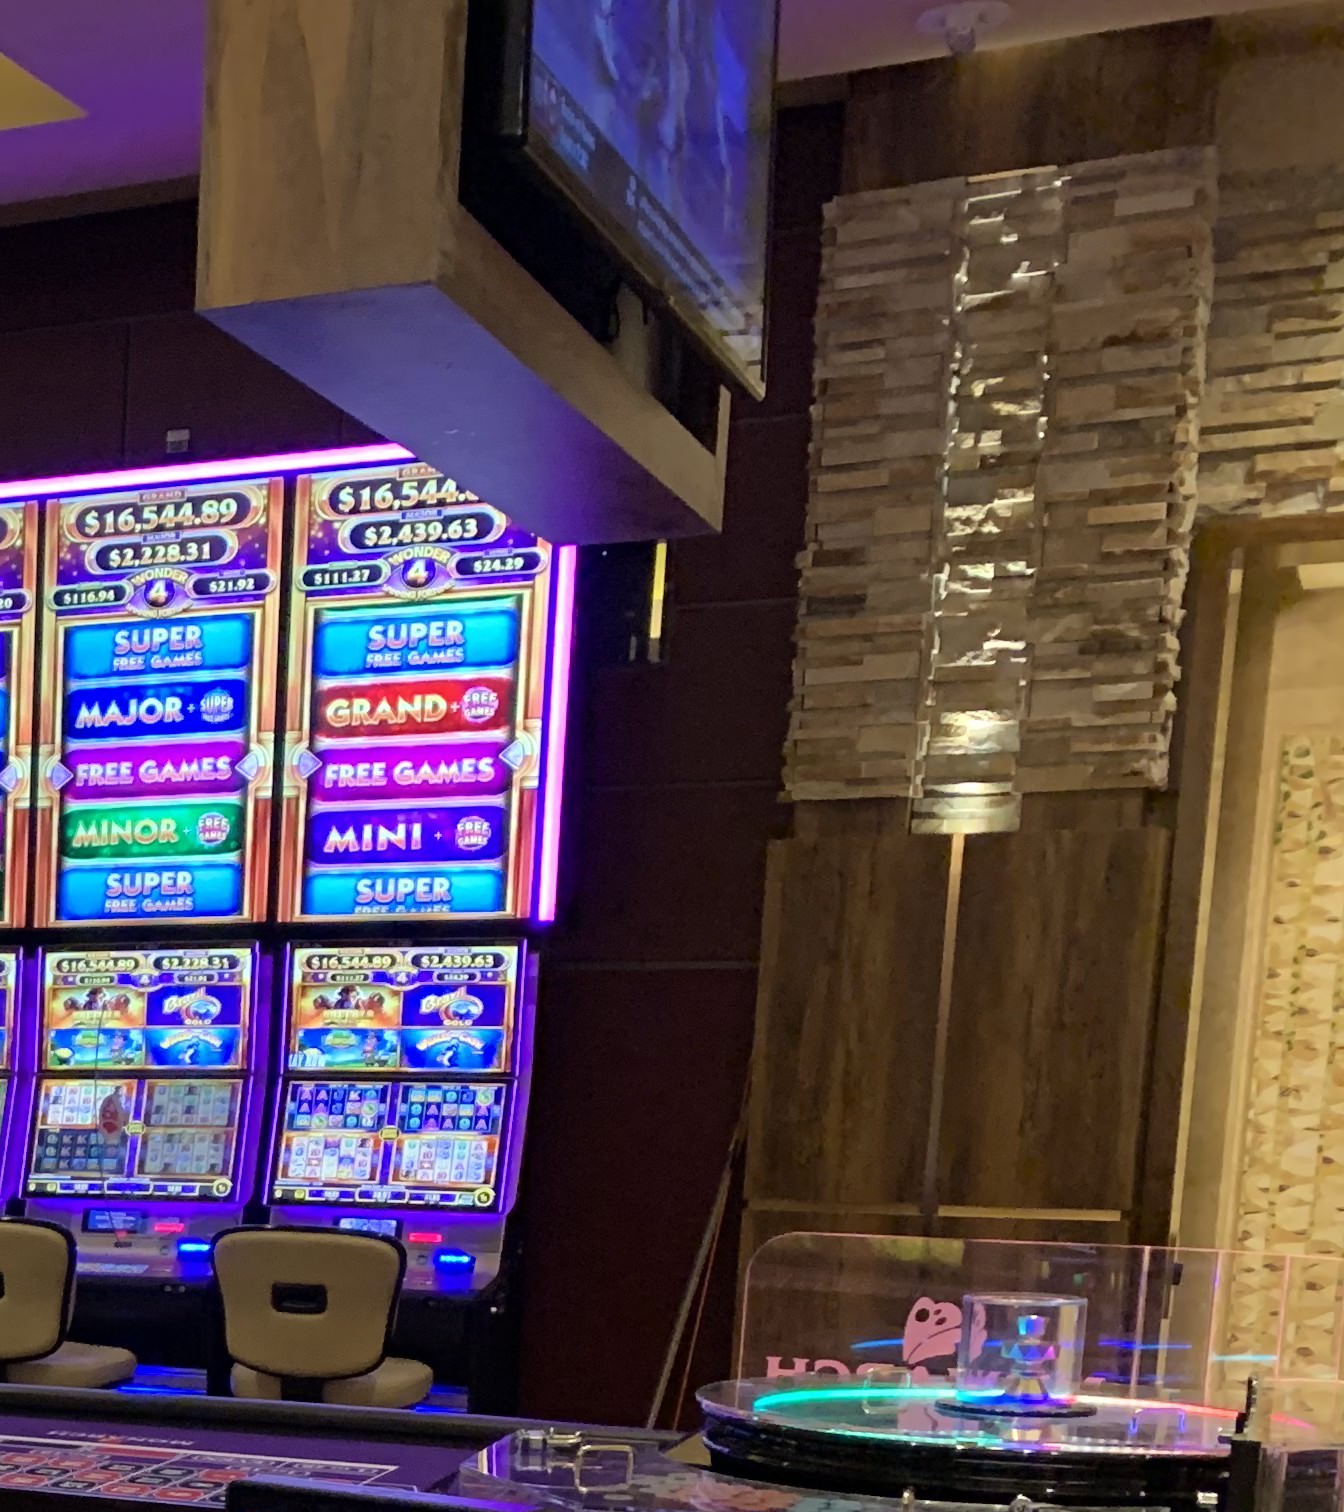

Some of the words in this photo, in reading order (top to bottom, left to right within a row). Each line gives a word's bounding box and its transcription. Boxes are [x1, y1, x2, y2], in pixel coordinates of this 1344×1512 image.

[85, 498, 238, 536] $16,544.89
[364, 518, 479, 546] $2,439.63
[109, 541, 211, 568] $2,228.31
[114, 625, 203, 655] SUPER
[367, 620, 465, 650] SUPER
[75, 696, 184, 728] MAJOR
[326, 694, 448, 727] GRAND
[76, 762, 134, 786] FREE
[139, 756, 232, 783] GAMES
[324, 761, 388, 788] FREE
[393, 757, 496, 785] GAMES
[72, 818, 178, 847] MINOR
[323, 822, 422, 853] MINI
[105, 871, 194, 897] SUPER
[355, 876, 453, 904] SUPER
